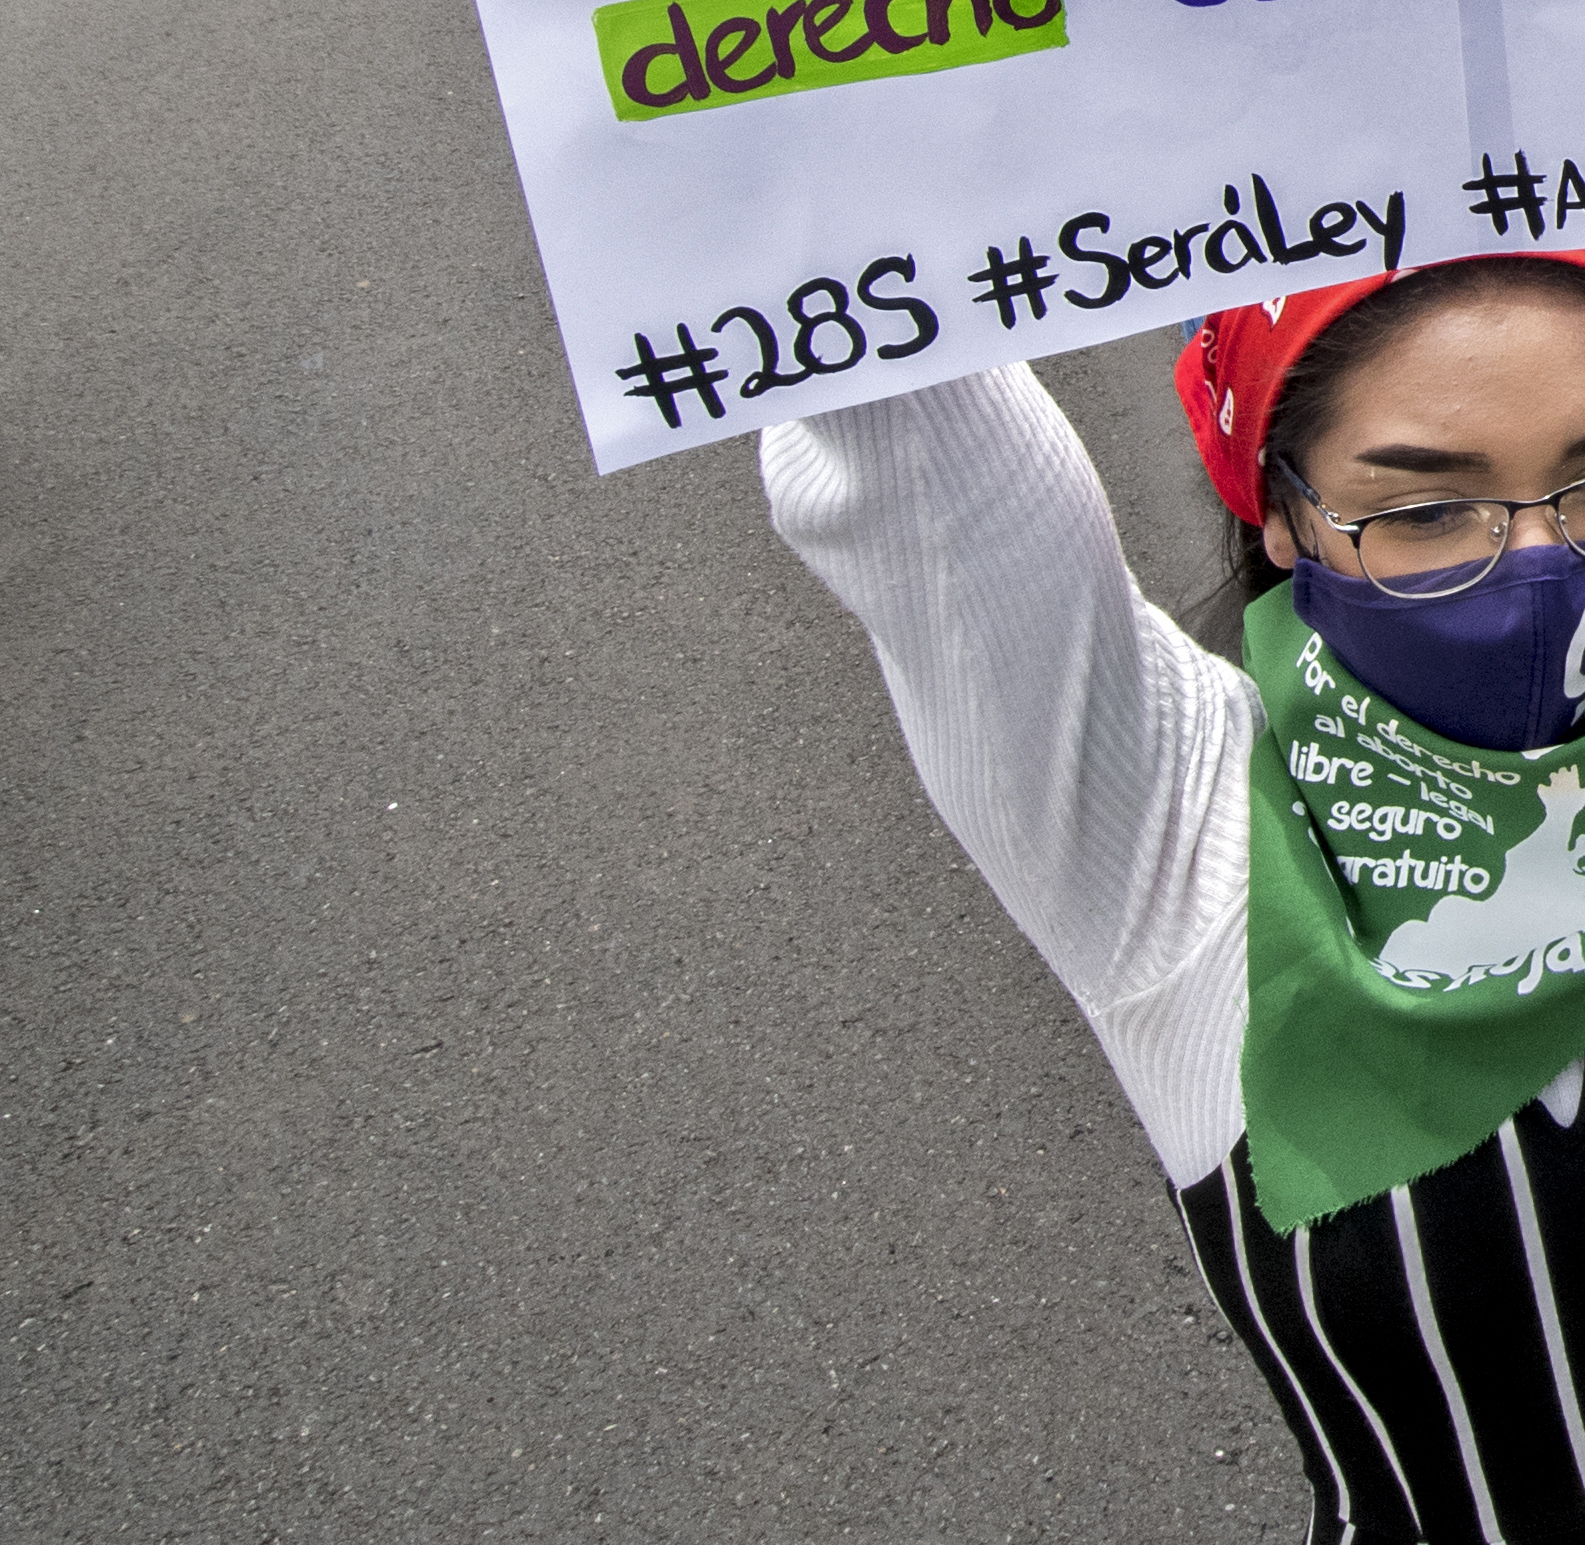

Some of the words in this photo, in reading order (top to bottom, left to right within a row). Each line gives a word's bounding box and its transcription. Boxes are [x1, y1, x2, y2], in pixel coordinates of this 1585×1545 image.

[615, 253, 940, 429] #28S
[966, 173, 1406, 330] #SeráLey
[1296, 632, 1336, 695] Por
[1341, 694, 1370, 725] el
[1376, 719, 1520, 786] derecho
[1314, 714, 1345, 738] al
[1357, 733, 1473, 800] aborto
[1289, 739, 1374, 787] libre
[1420, 781, 1495, 835] legal
[1327, 800, 1463, 842] seguro
